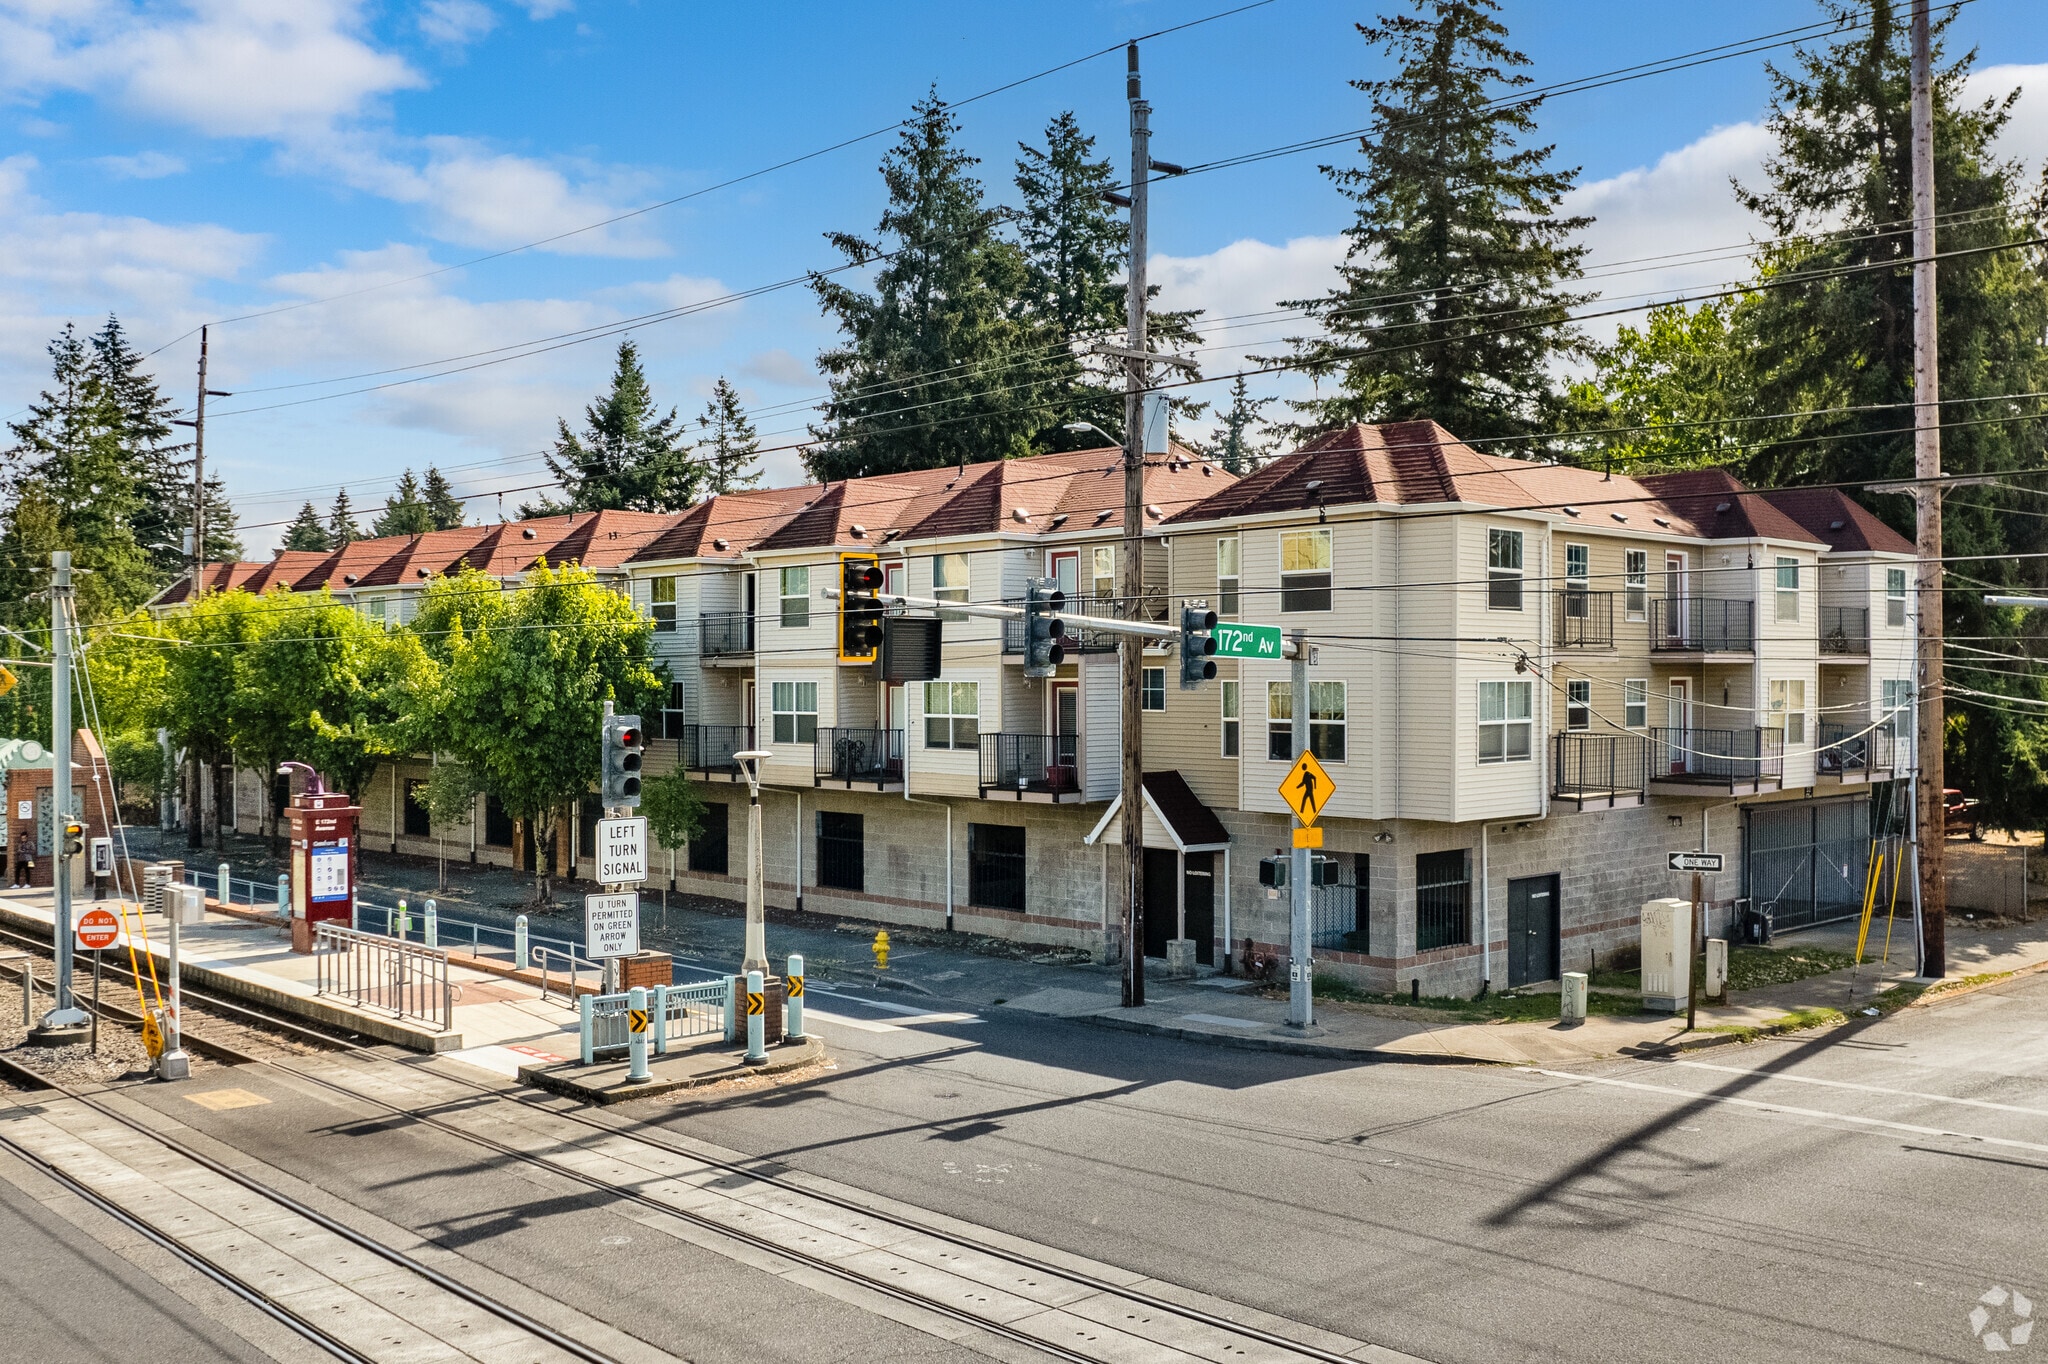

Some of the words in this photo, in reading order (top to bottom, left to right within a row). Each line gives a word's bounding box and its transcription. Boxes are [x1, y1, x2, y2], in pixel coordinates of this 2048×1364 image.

[1218, 629, 1254, 652] 172nd
[1258, 637, 1274, 653] Av
[610, 826, 635, 839] LEFT
[609, 844, 637, 857] TURN
[1684, 858, 1699, 866] ONE
[603, 861, 642, 875] SIGNAL
[598, 901, 604, 909] U
[607, 899, 627, 909] TURN
[592, 909, 633, 920] PERMITTED
[593, 922, 604, 932] ON
[607, 920, 632, 931] GREEN
[600, 931, 627, 942] ARROW
[603, 942, 622, 952] ONLY
